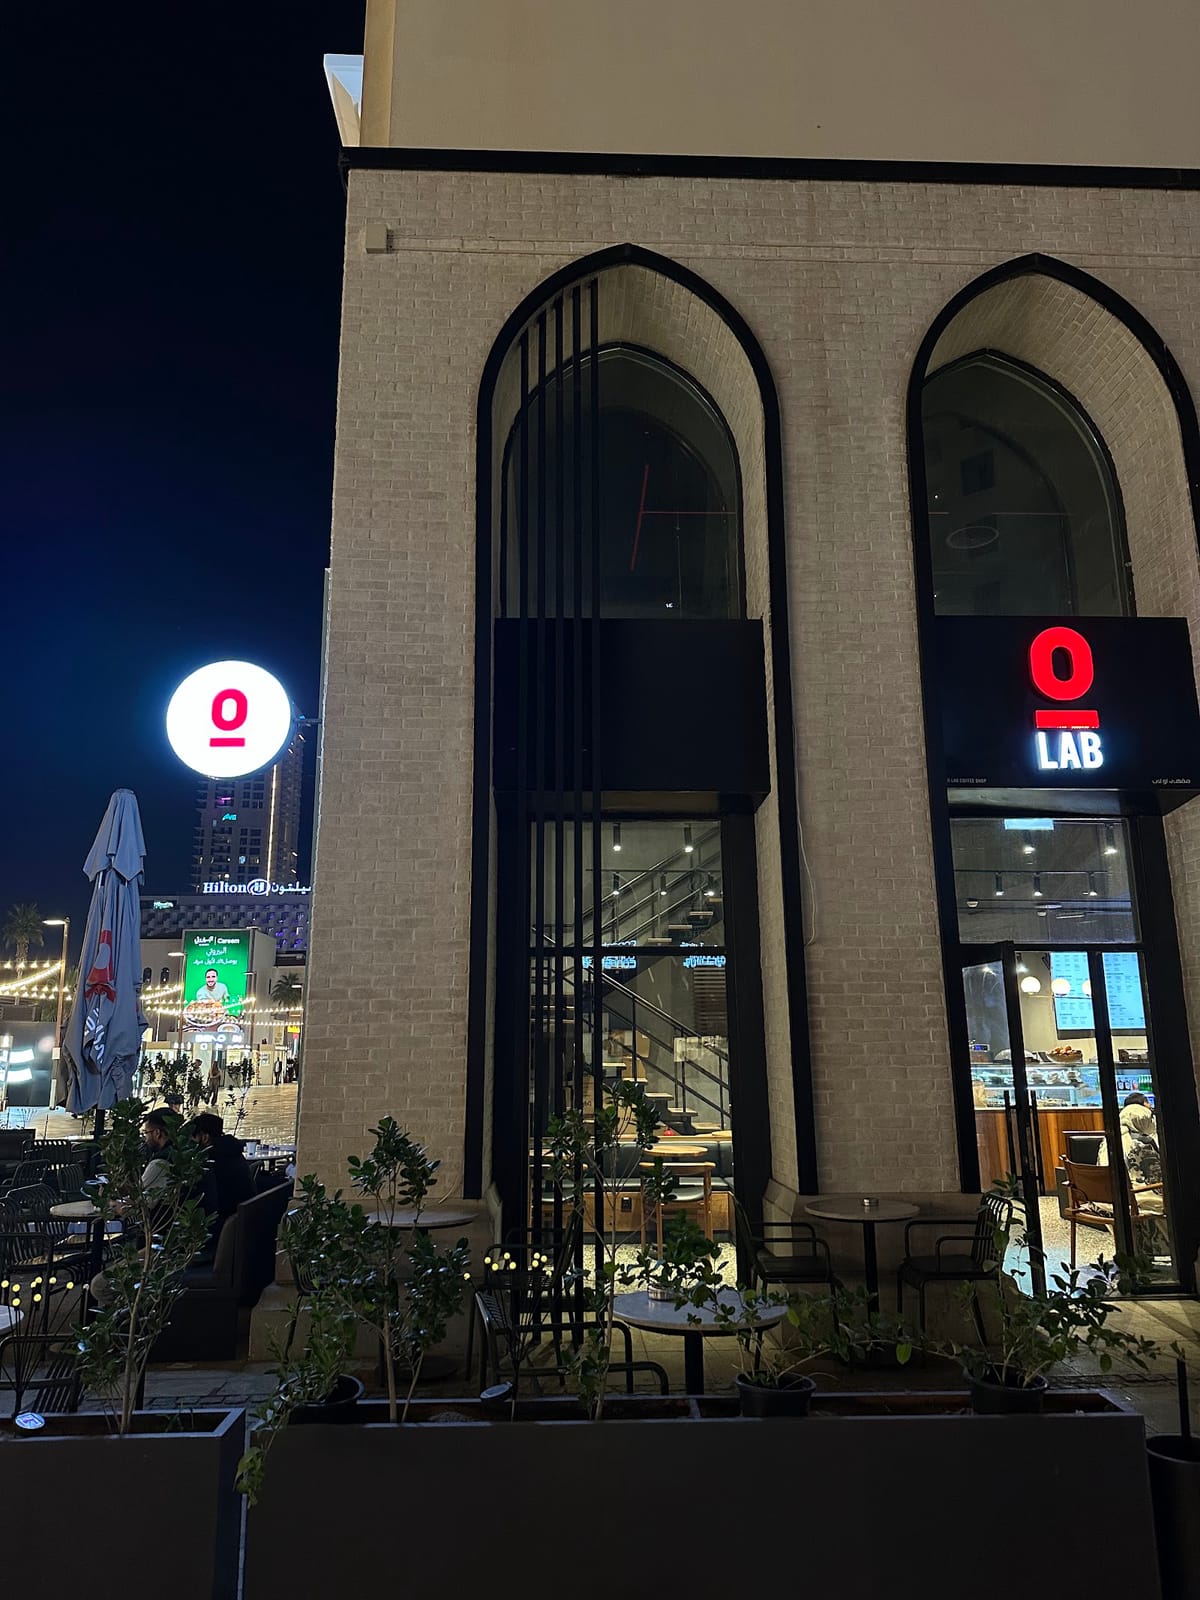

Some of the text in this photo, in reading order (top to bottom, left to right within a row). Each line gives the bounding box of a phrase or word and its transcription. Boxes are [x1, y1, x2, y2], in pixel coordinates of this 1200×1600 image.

[1030, 626, 1095, 701] O
[1036, 731, 1104, 770] LAB
[203, 881, 247, 894] Hilton
